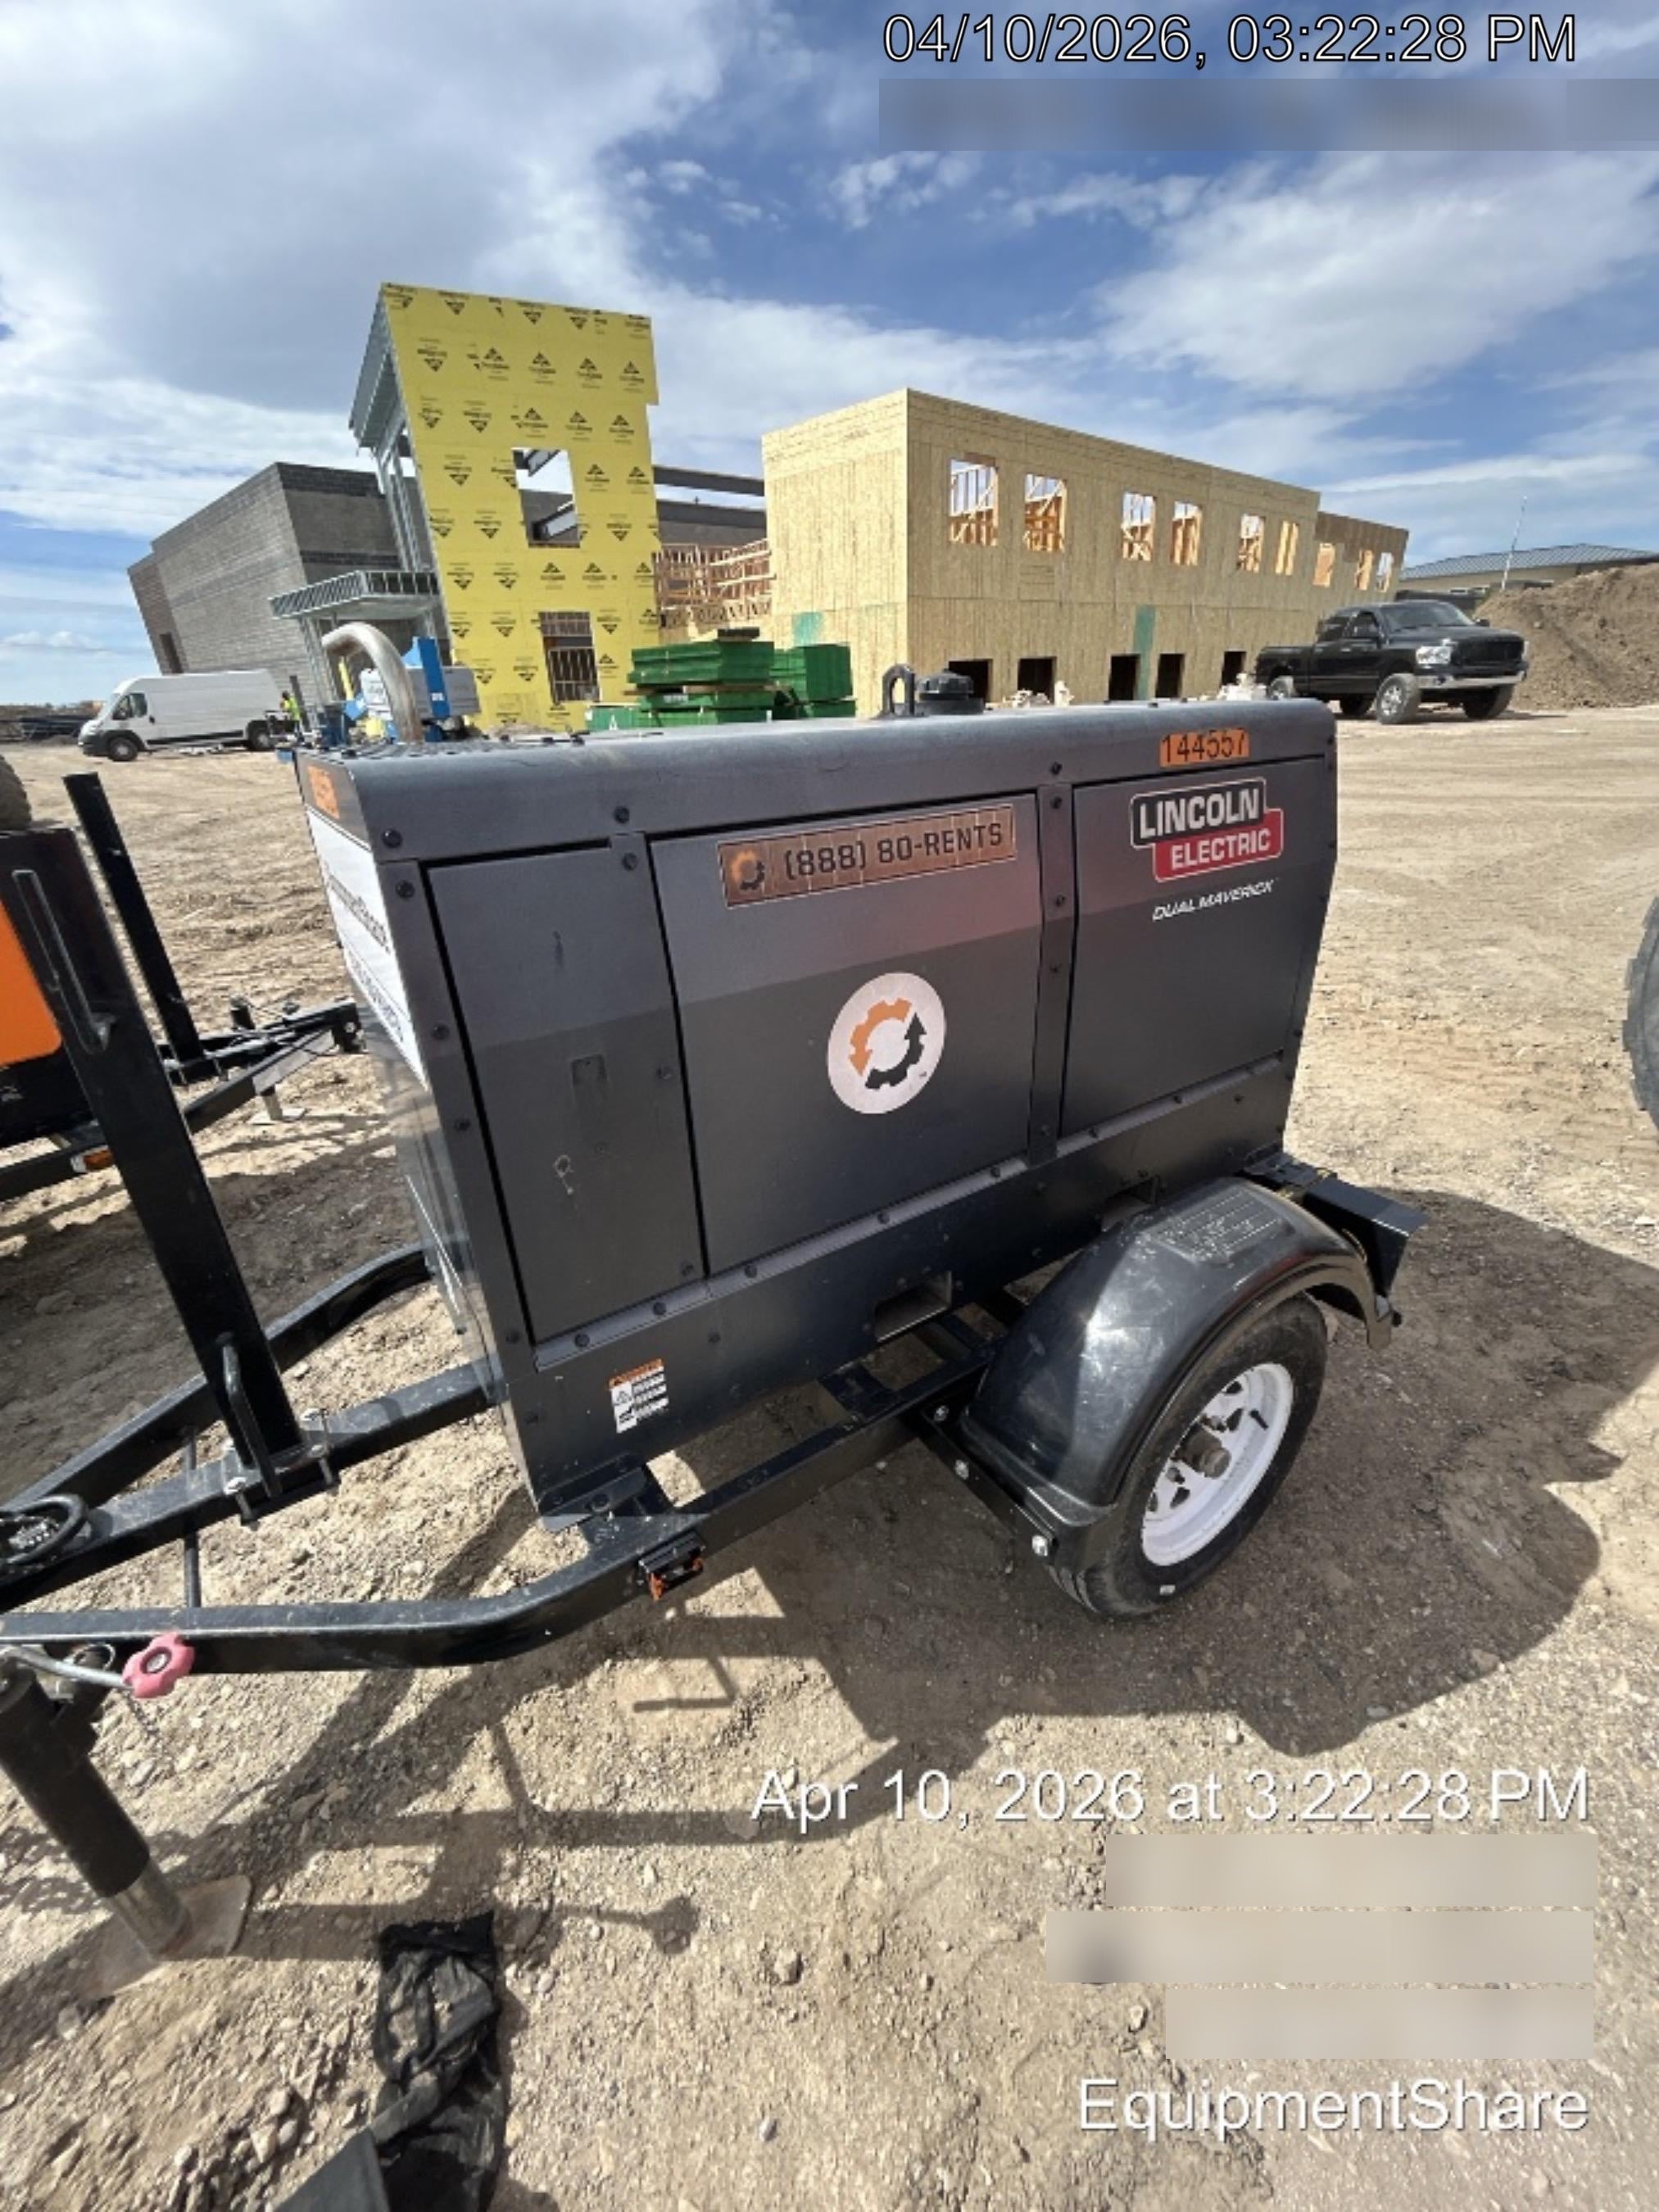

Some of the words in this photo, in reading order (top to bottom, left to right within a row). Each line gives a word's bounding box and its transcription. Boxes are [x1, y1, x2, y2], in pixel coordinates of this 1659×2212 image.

[1162, 728, 1245, 763] 144557
[1139, 787, 1259, 839] LINCOLN
[784, 841, 867, 880] (888)
[877, 823, 1003, 864] 80-RENTS
[1171, 828, 1271, 870] ELECTRIC
[1153, 898, 1196, 922] DUAL
[1198, 879, 1275, 909] MAVERICK
